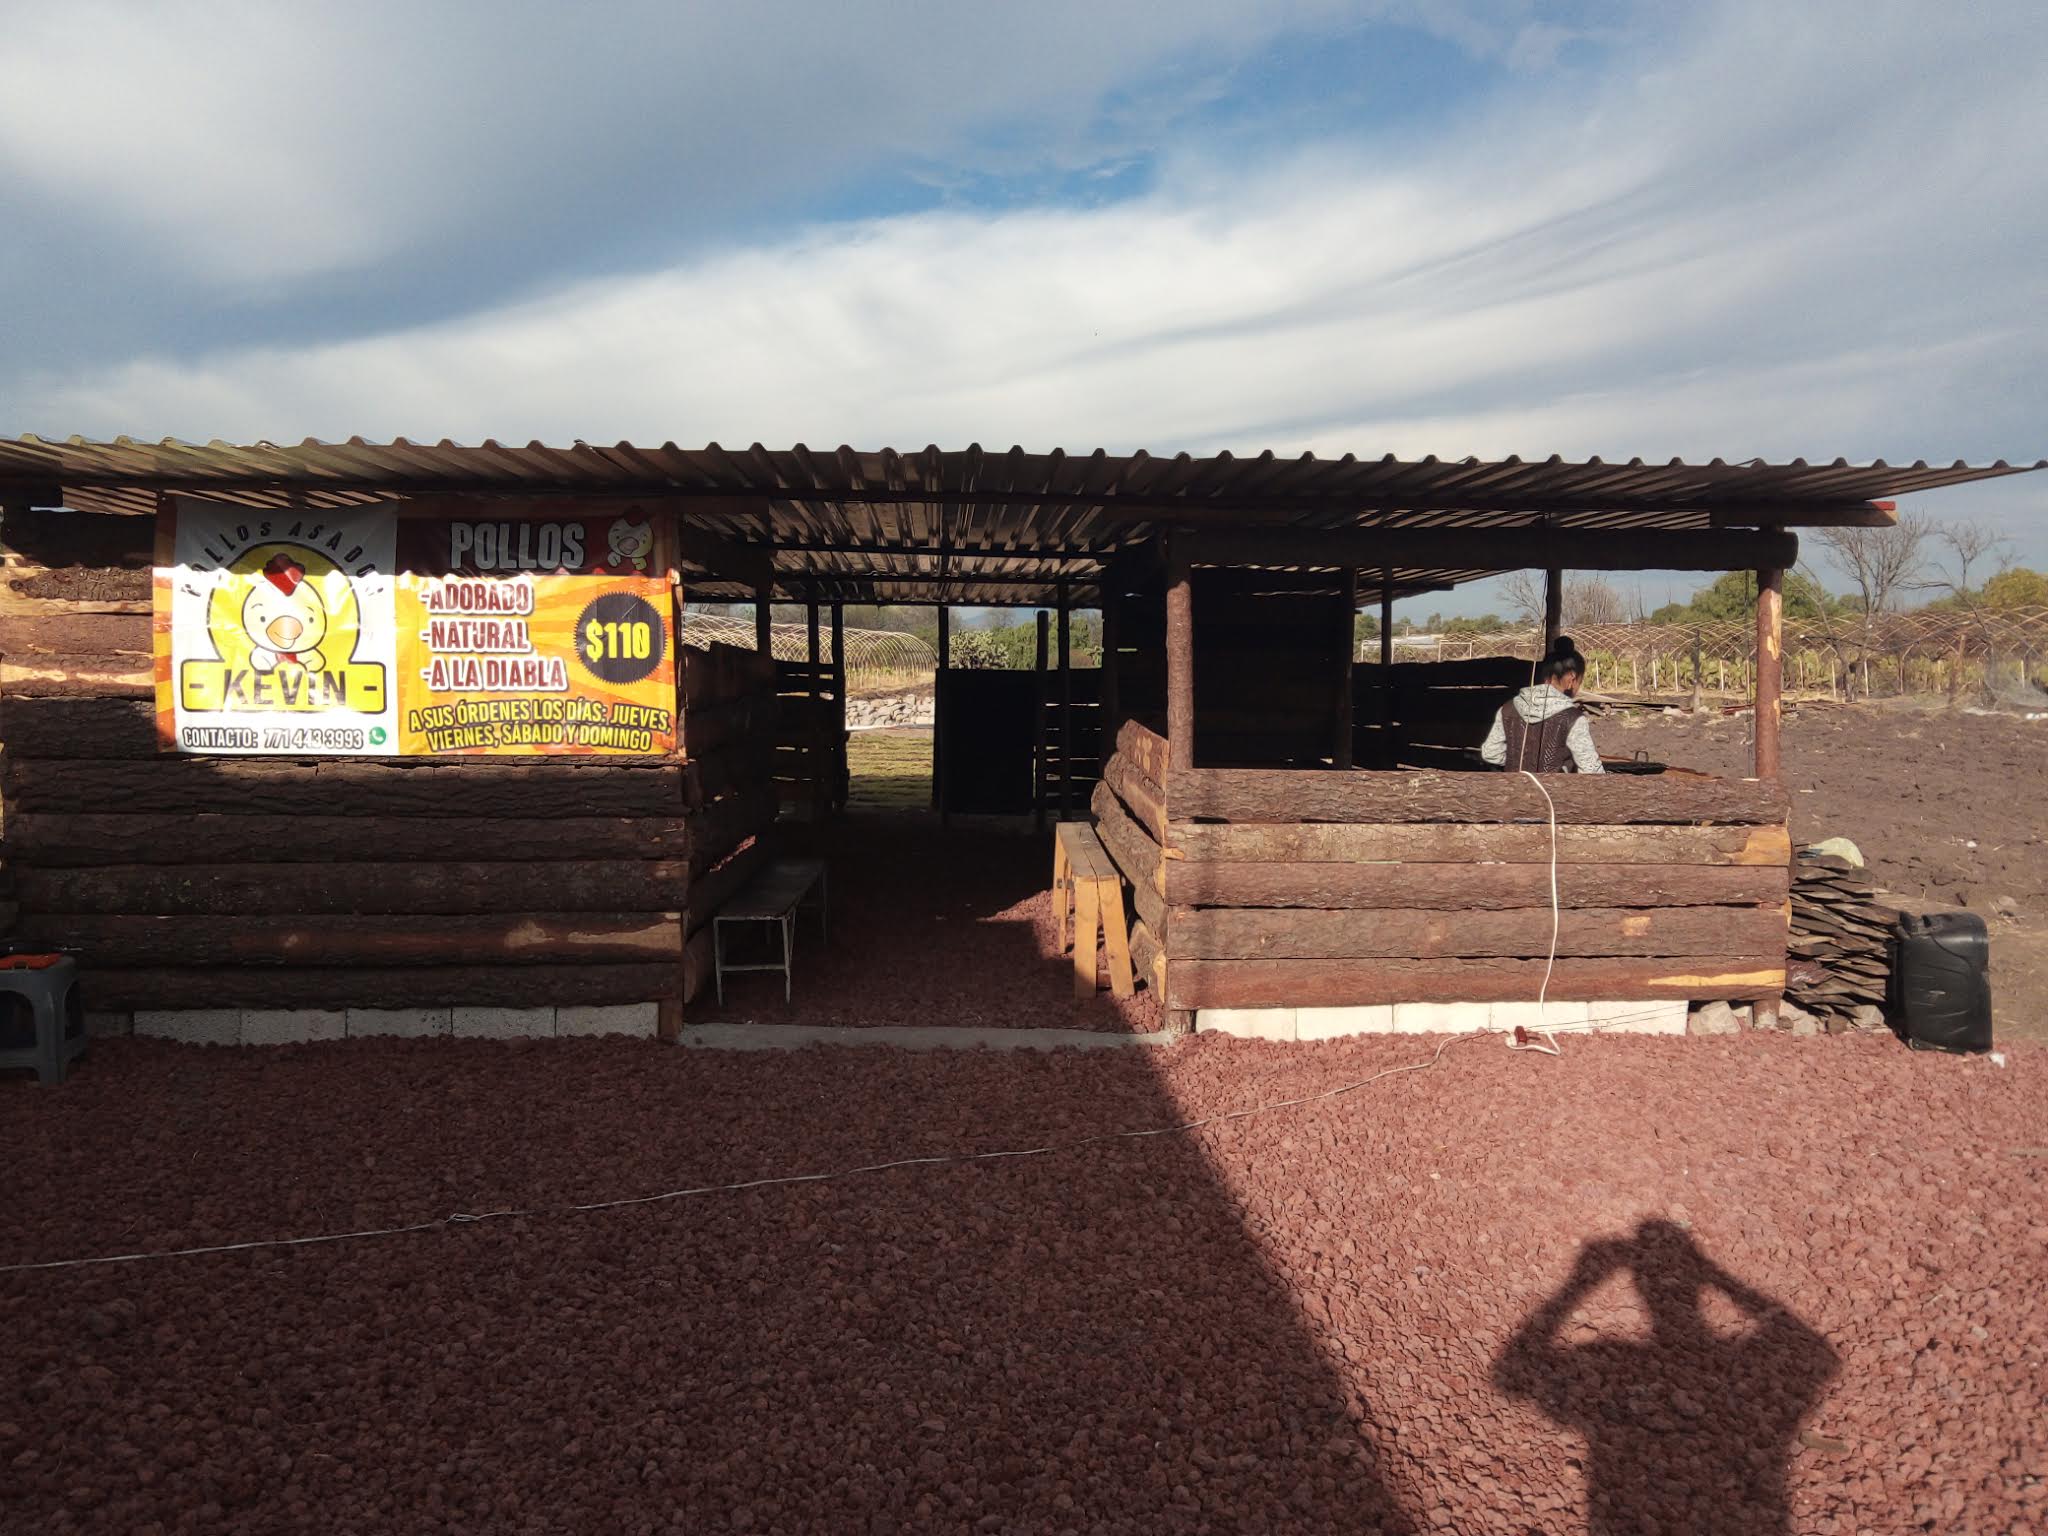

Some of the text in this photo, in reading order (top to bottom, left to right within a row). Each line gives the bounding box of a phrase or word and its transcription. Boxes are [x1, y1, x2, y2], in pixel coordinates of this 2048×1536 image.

[288, 521, 384, 597] ASADO
[451, 522, 585, 570] POLLOS
[585, 619, 651, 663] $110
[223, 669, 346, 706] KEVIN
[452, 659, 480, 687] LA
[486, 659, 564, 687] DIABLA
[409, 697, 673, 735] A SUS ÓRDENES LOS DÍAS: JUEVES,
[183, 727, 259, 749] CONTACTO:
[426, 720, 653, 753] VIERNES, SÁBADO Y DOMINGO
